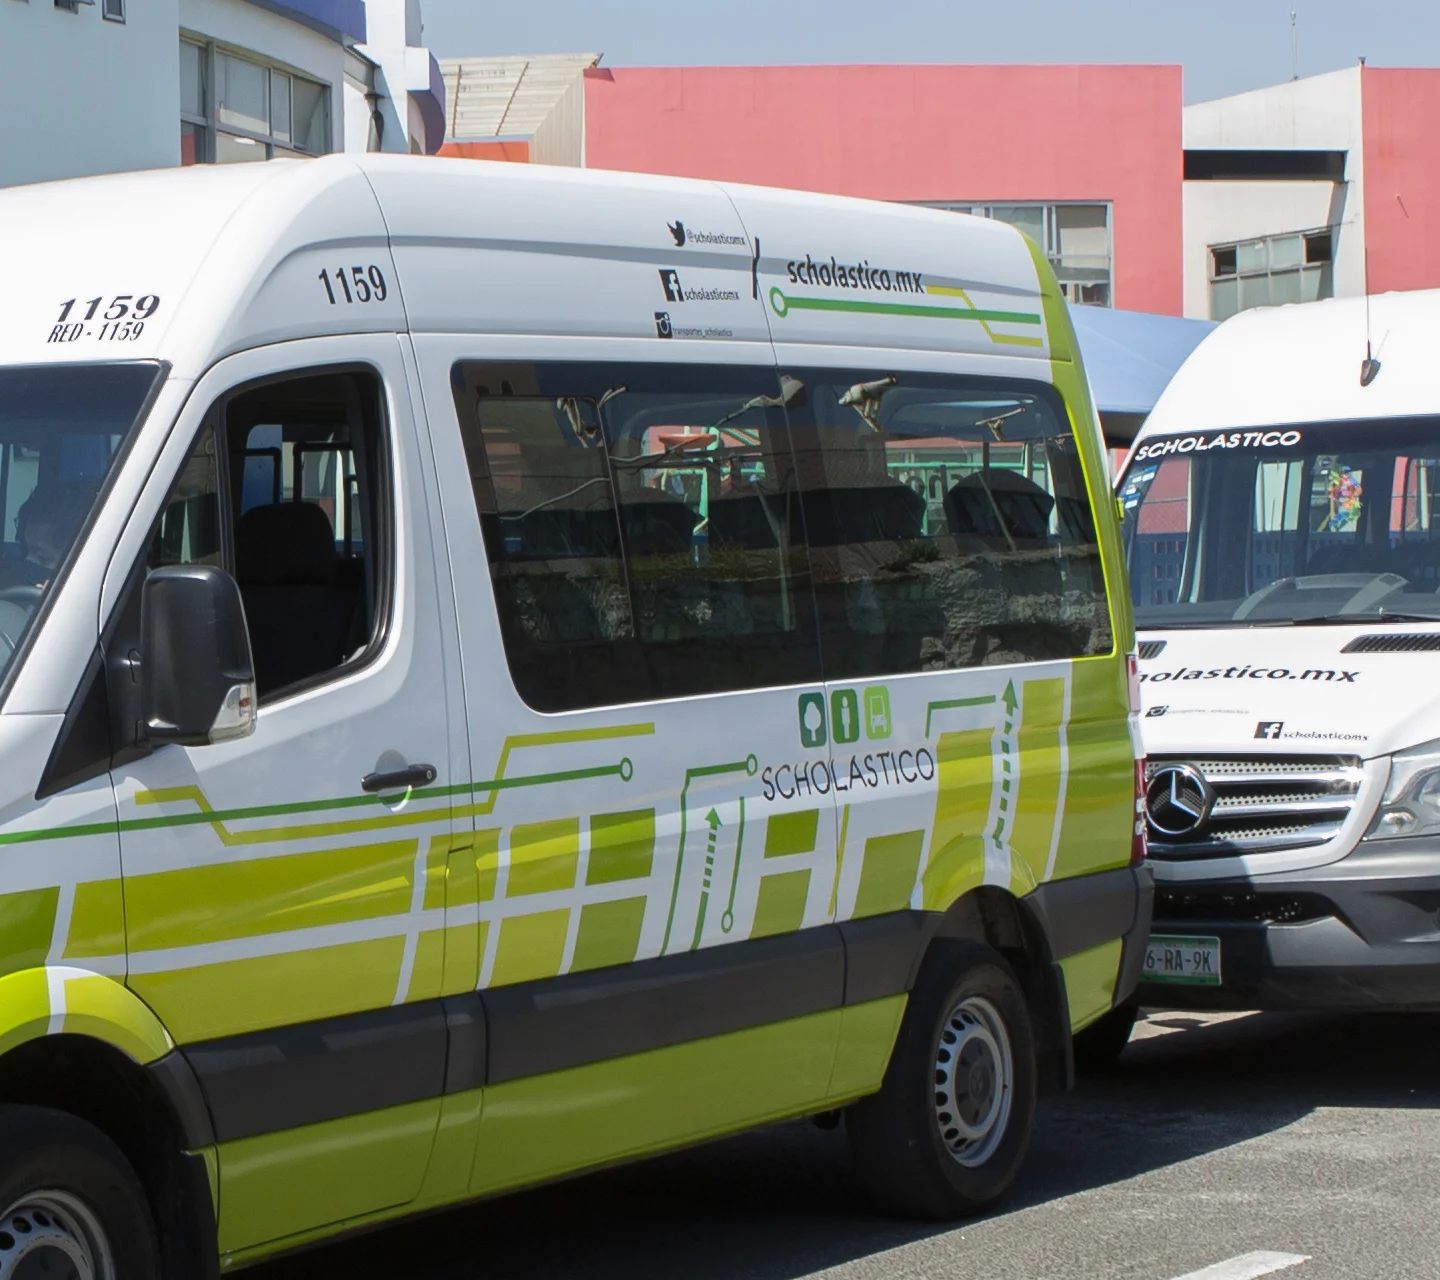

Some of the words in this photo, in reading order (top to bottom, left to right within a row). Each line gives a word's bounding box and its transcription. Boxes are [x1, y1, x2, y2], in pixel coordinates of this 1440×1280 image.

[686, 229, 746, 245] @scholasticomx
[318, 265, 387, 305] 1159
[787, 254, 925, 294] scholastico.mx
[684, 288, 739, 301] scholasticomx
[57, 295, 161, 322] 1159
[47, 323, 84, 343] RED
[98, 322, 145, 341] 1159
[1134, 431, 1301, 461] SCHOLASTICO
[1283, 730, 1369, 741] scholasticomx
[762, 748, 935, 801] SCHOLASTICO
